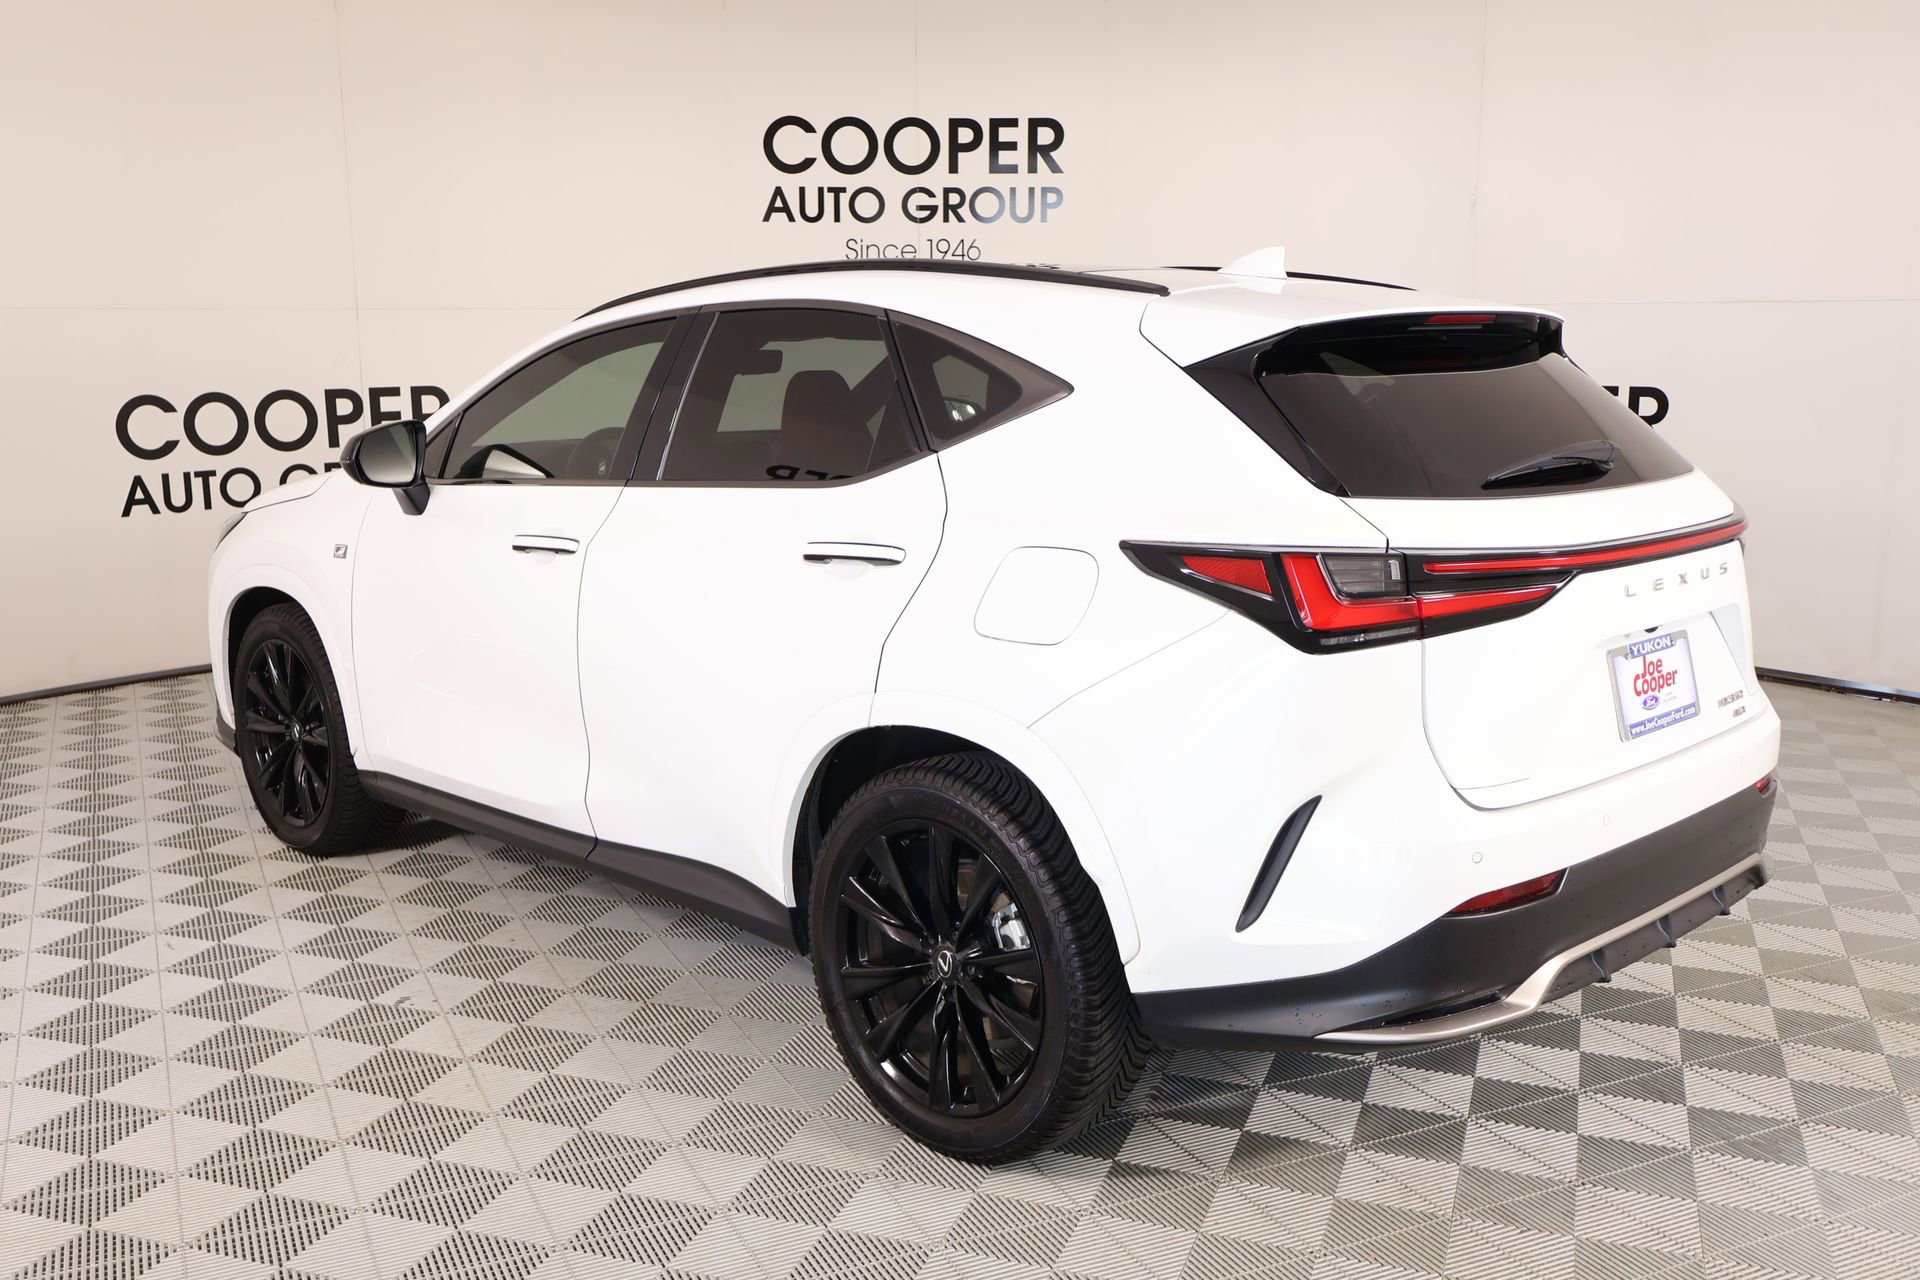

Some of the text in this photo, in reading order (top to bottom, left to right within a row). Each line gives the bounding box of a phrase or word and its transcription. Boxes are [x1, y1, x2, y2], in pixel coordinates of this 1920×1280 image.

[763, 115, 1065, 175] COOPER
[762, 186, 1064, 224] AUTO GROUP
[845, 238, 981, 261] Since 1946
[121, 467, 261, 517] AUTO
[1624, 562, 1728, 597] LEXUS
[1631, 635, 1672, 656] YUKON
[1641, 655, 1663, 679] Joe
[1633, 669, 1678, 697] Cooper
